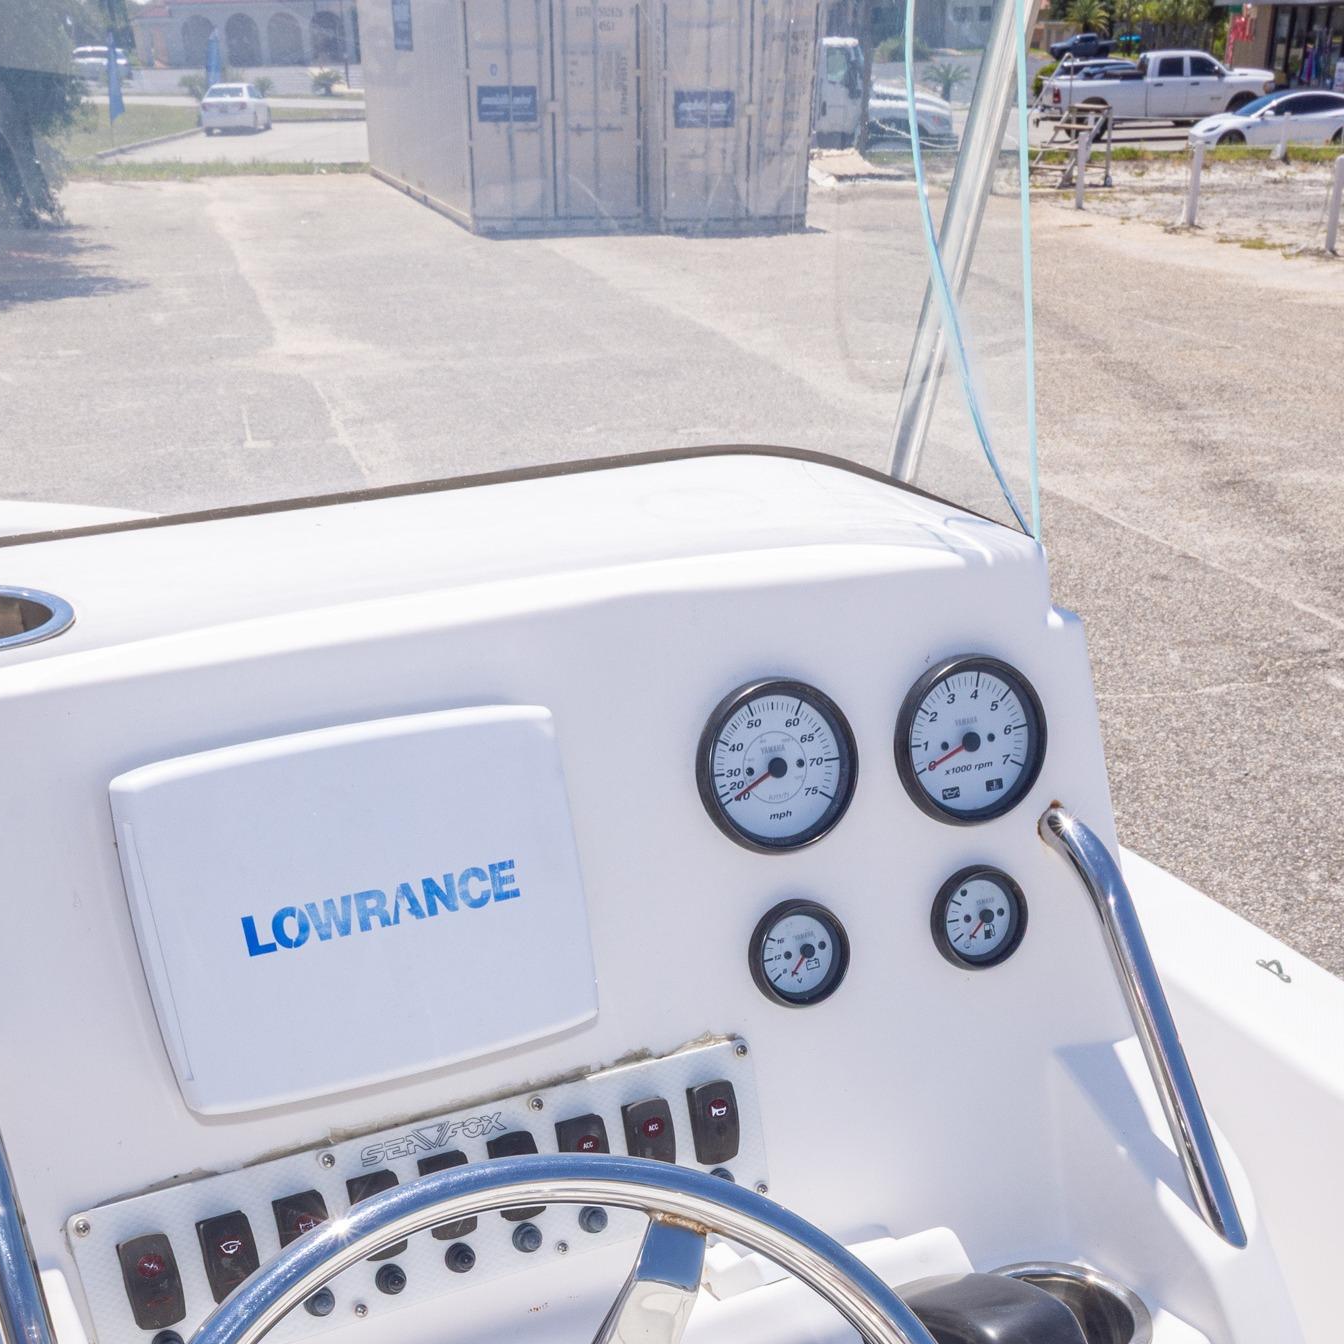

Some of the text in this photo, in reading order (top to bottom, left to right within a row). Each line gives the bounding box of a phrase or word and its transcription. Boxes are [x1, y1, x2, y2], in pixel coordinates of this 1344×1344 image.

[947, 693, 956, 705] 3
[970, 689, 979, 700] 4
[990, 700, 999, 711] 5
[928, 711, 938, 722] 2
[955, 716, 978, 726] YAMAHA
[746, 718, 762, 729] 50
[785, 717, 800, 728] 60
[1003, 724, 1012, 735] 6
[800, 733, 815, 743] 65
[728, 743, 744, 752] 40
[760, 743, 786, 755] YAMAHA
[923, 741, 929, 751] 1
[809, 757, 823, 766] 70
[1002, 754, 1011, 765] 7
[928, 761, 936, 771] 0
[944, 761, 993, 776] x1000 rpm
[726, 768, 741, 778] 30
[729, 781, 744, 791] 20
[804, 787, 819, 796] 75
[769, 810, 792, 821] mph
[241, 859, 521, 957] LOWRANCE
[777, 937, 785, 945] 16
[648, 1123, 659, 1132] ACC
[583, 1141, 594, 1150] ACC
